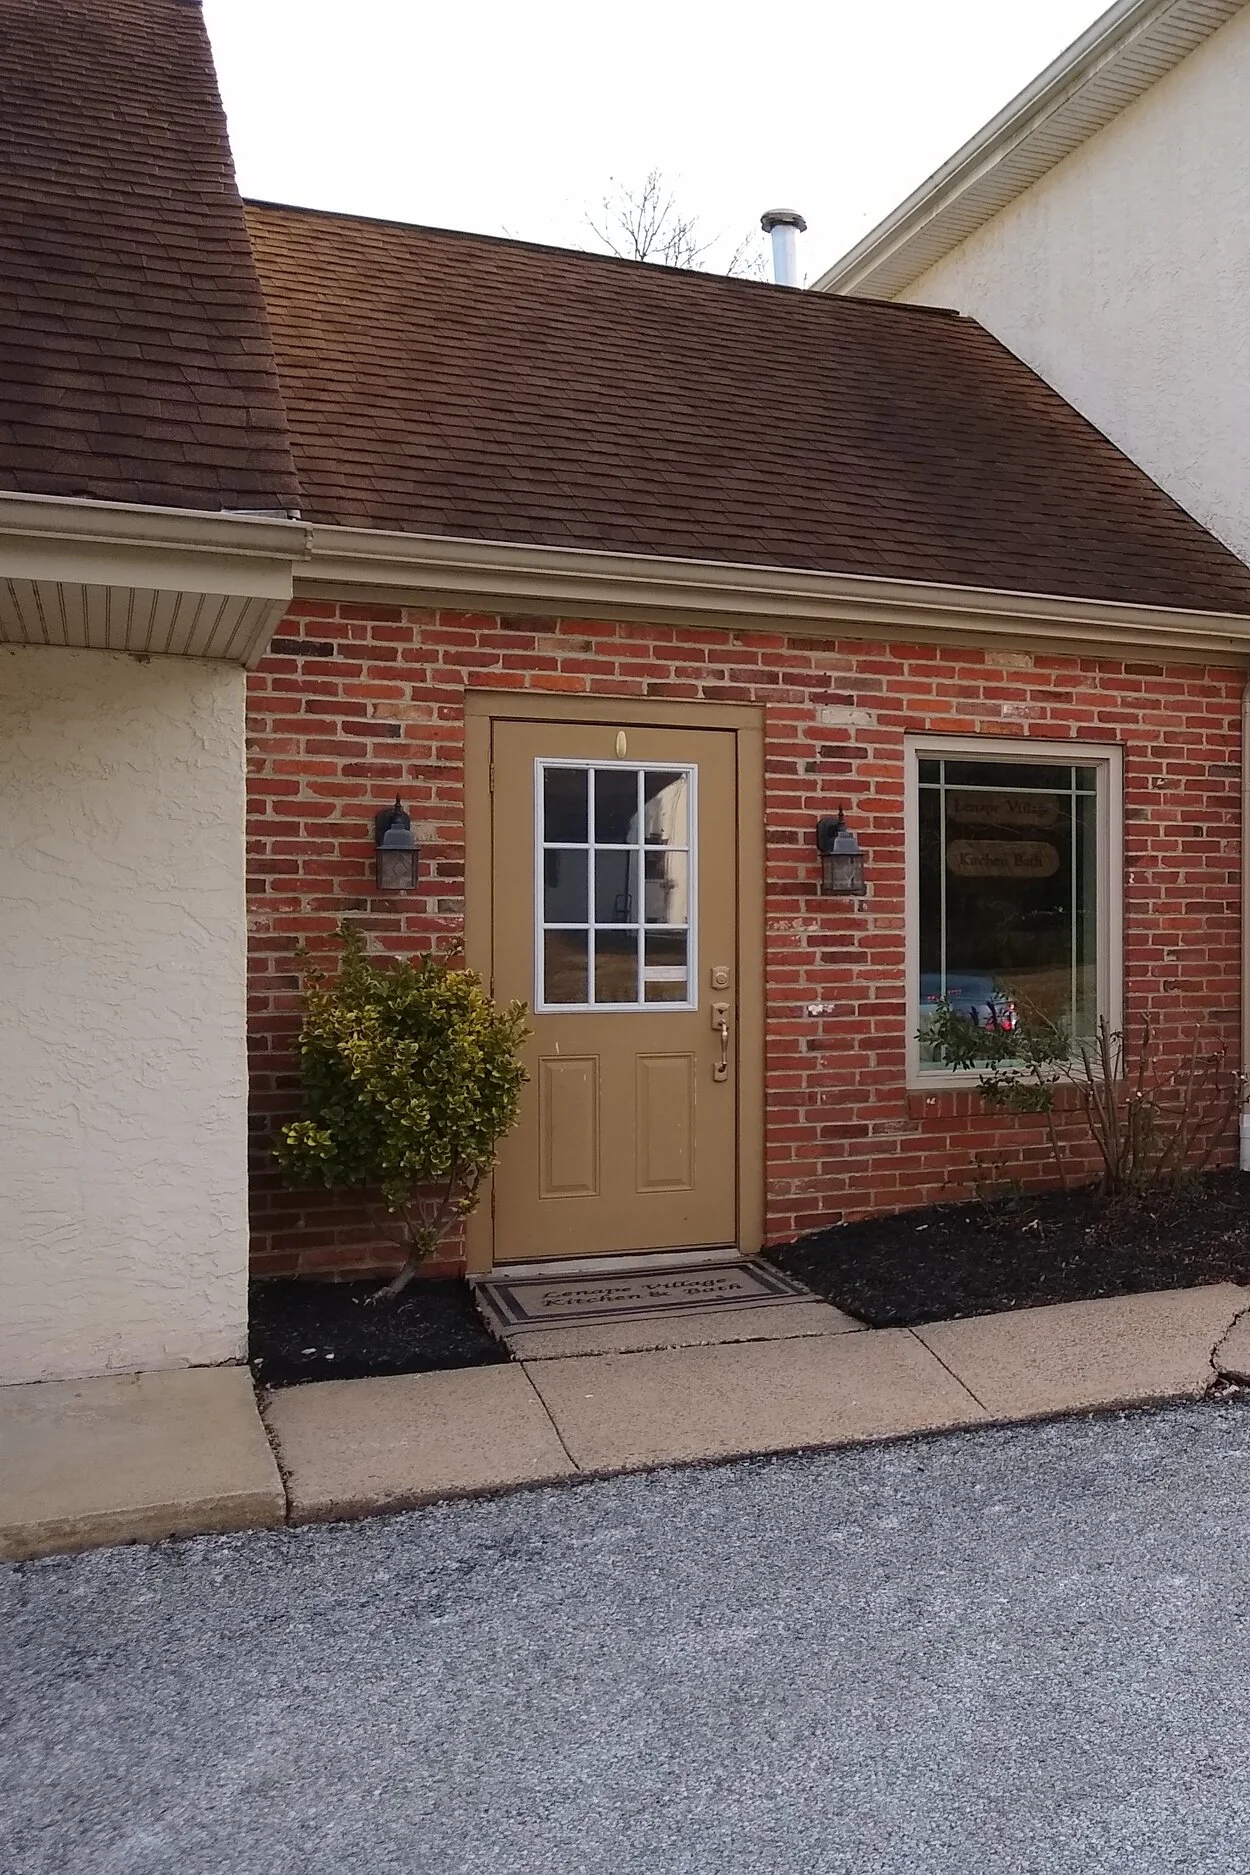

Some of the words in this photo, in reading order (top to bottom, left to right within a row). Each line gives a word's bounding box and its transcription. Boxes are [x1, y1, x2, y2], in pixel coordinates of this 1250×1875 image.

[1014, 853, 1044, 867] Bath
[541, 1286, 632, 1298] Lenape
[642, 1277, 728, 1289] Village
[541, 1293, 641, 1307] Kitchen
[683, 1284, 744, 1294] Bath
